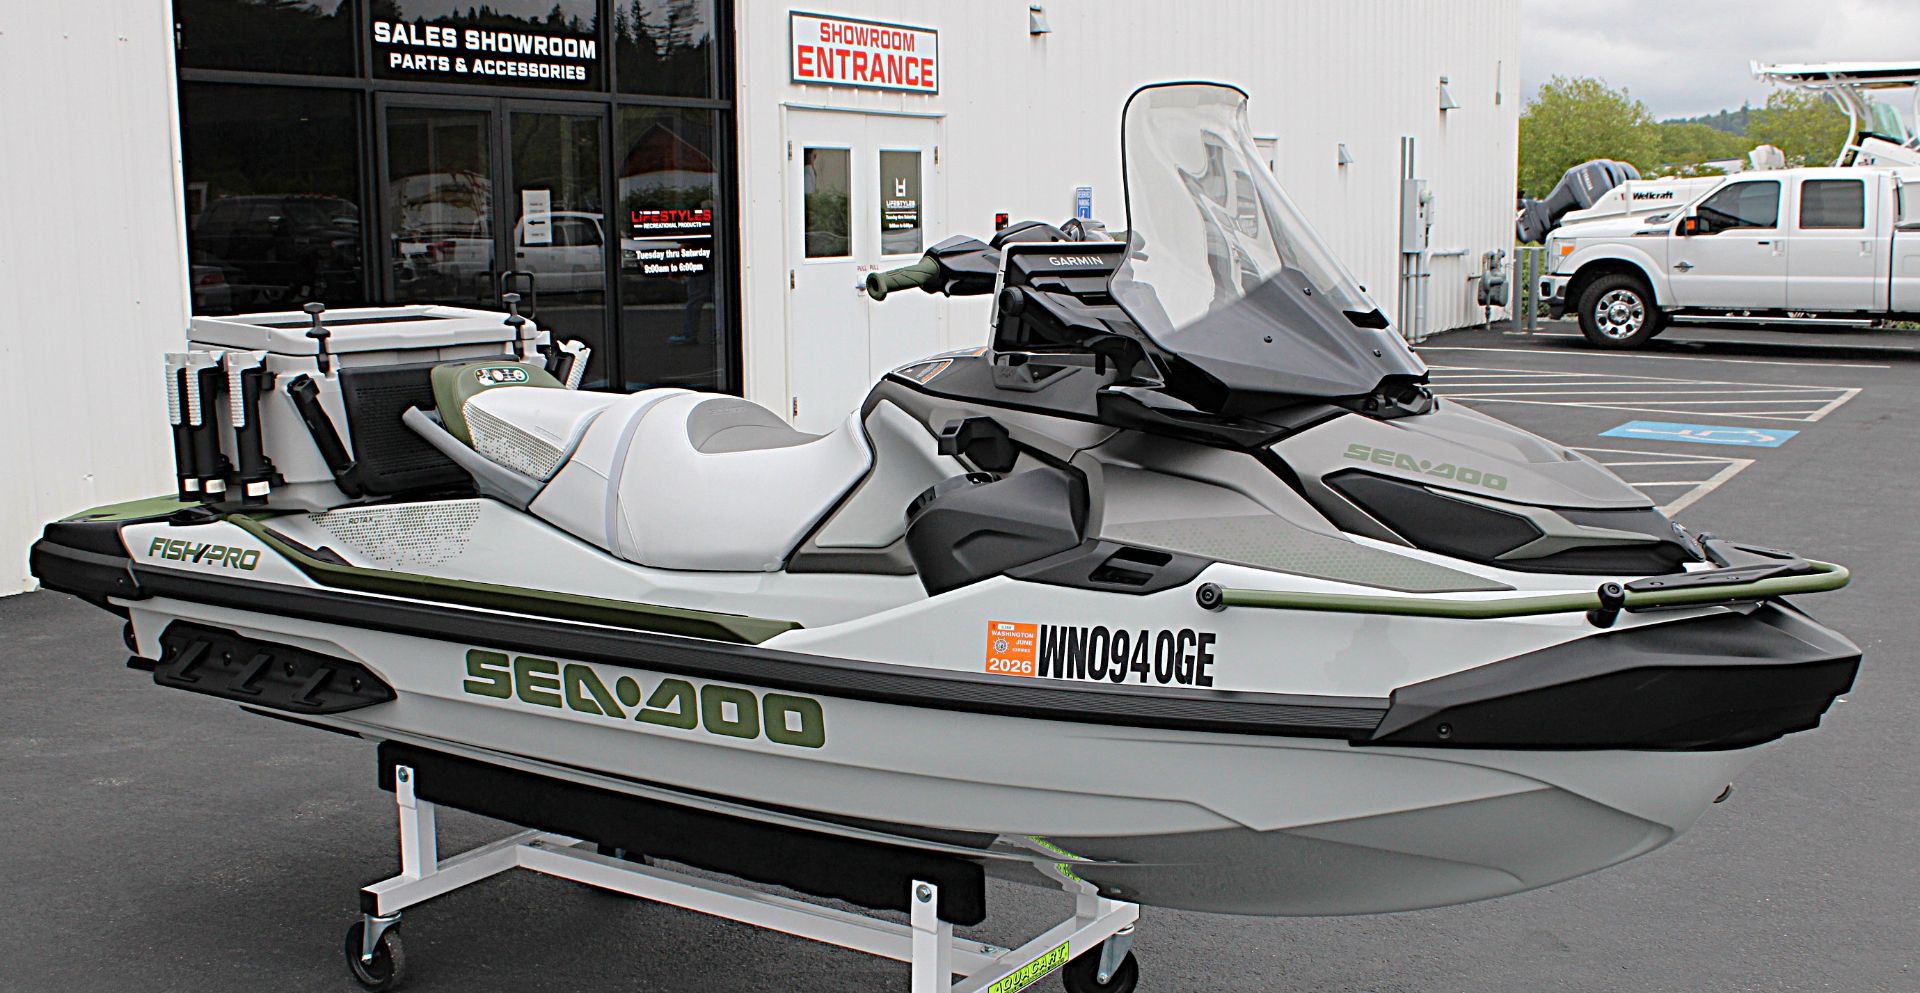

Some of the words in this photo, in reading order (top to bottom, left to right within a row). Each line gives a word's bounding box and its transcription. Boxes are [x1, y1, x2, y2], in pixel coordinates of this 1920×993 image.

[374, 21, 457, 48] SALES
[465, 29, 596, 59] SHOWROOM
[820, 22, 915, 52] SHOWROOM
[390, 52, 450, 71] PARTS
[455, 57, 468, 73] &
[473, 58, 586, 80] ACCESSORIES
[797, 44, 934, 87] ENTRANCE
[1632, 191, 1673, 200] Wellcraft
[636, 250, 664, 260] Tuesday
[666, 249, 680, 258] thru
[681, 248, 711, 258] Saturday
[1049, 256, 1104, 266] GARMIN
[644, 264, 670, 273] 9:00am
[670, 263, 678, 272] to
[679, 262, 703, 273] 6:00pm
[349, 516, 373, 525] ROTAX
[991, 630, 1034, 638] WASHINGTON
[989, 657, 1032, 674] 2026
